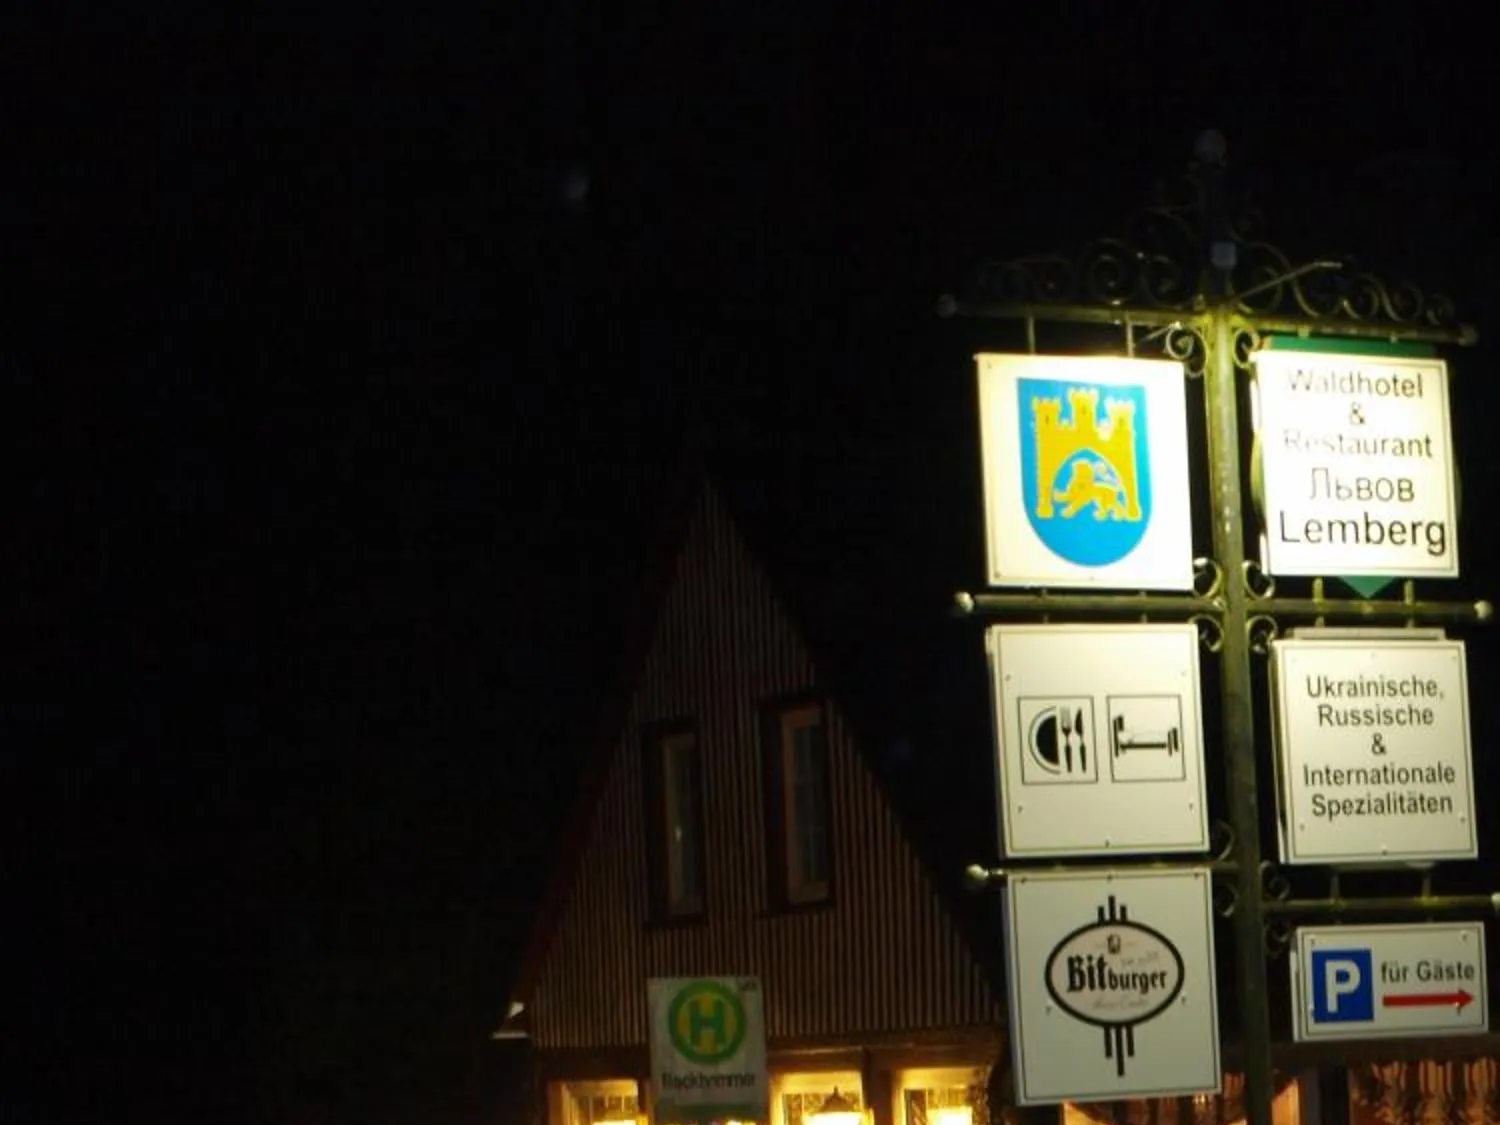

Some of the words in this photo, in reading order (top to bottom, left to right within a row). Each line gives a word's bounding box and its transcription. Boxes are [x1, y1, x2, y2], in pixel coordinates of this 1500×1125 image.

[1287, 368, 1424, 399] Waldhotel
[1349, 401, 1366, 426] &
[1279, 510, 1447, 557] Lemberg
[1306, 674, 1445, 699] Ukrainische,
[1317, 703, 1435, 727] Russische
[1371, 732, 1387, 756] &
[1303, 761, 1457, 787] Internationale
[1311, 790, 1454, 821] Spezialitäten
[1066, 953, 1168, 994] Bitburger
[1325, 959, 1361, 1014] P
[1380, 960, 1409, 983] für
[1416, 960, 1476, 982] Gäste
